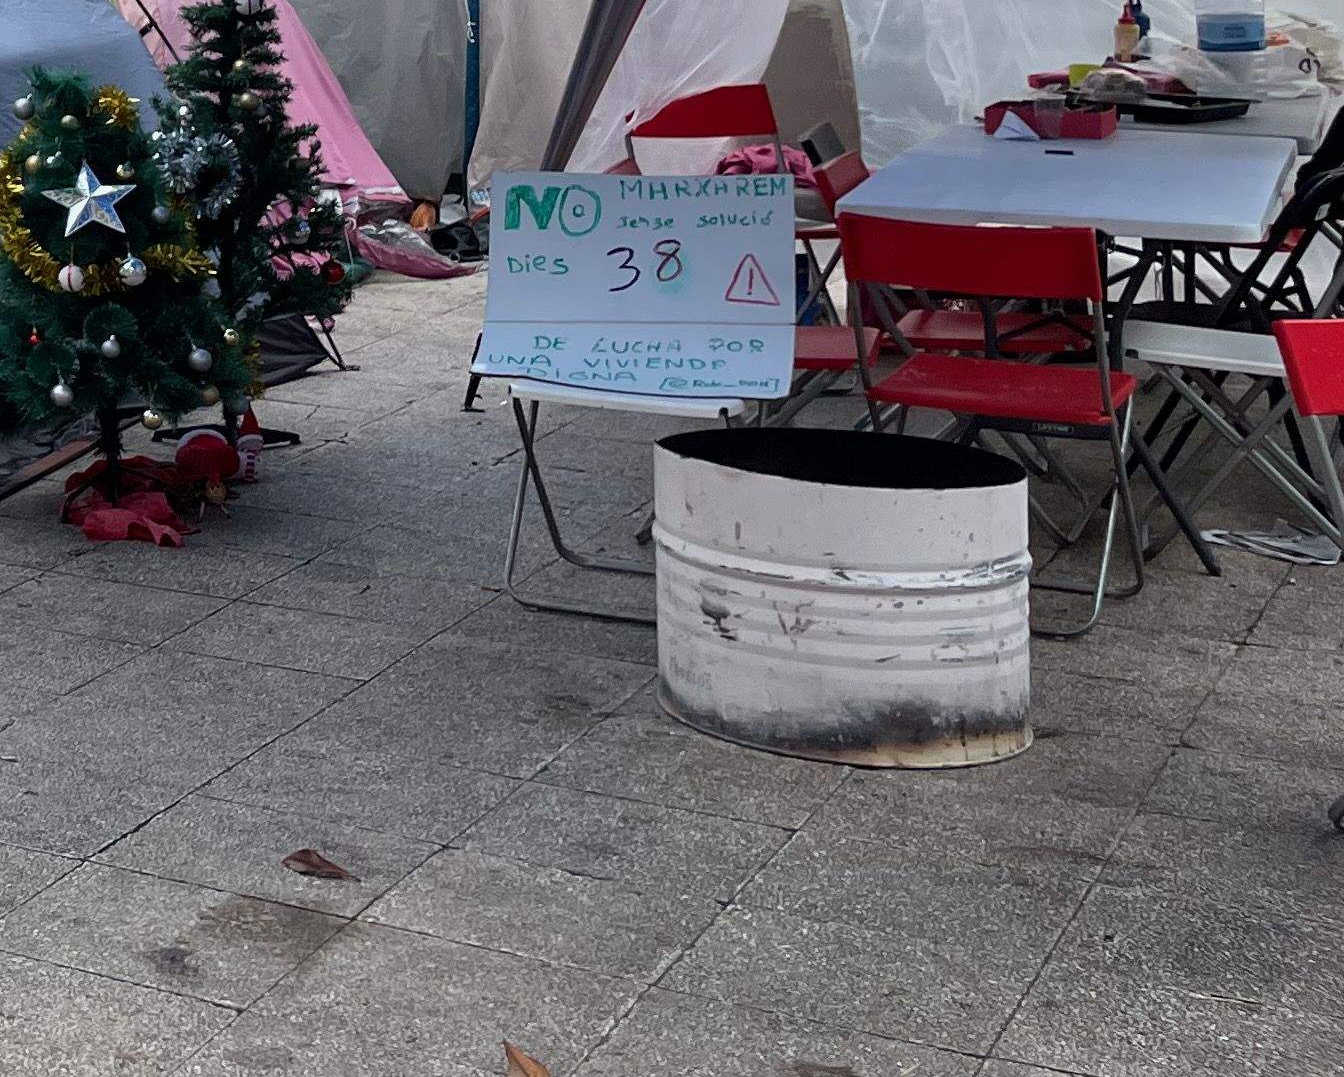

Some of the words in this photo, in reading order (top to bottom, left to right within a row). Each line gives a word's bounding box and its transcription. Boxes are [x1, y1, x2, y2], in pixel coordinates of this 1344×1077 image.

[504, 183, 602, 237] NO
[606, 238, 684, 292] 38
[534, 335, 568, 350] DE
